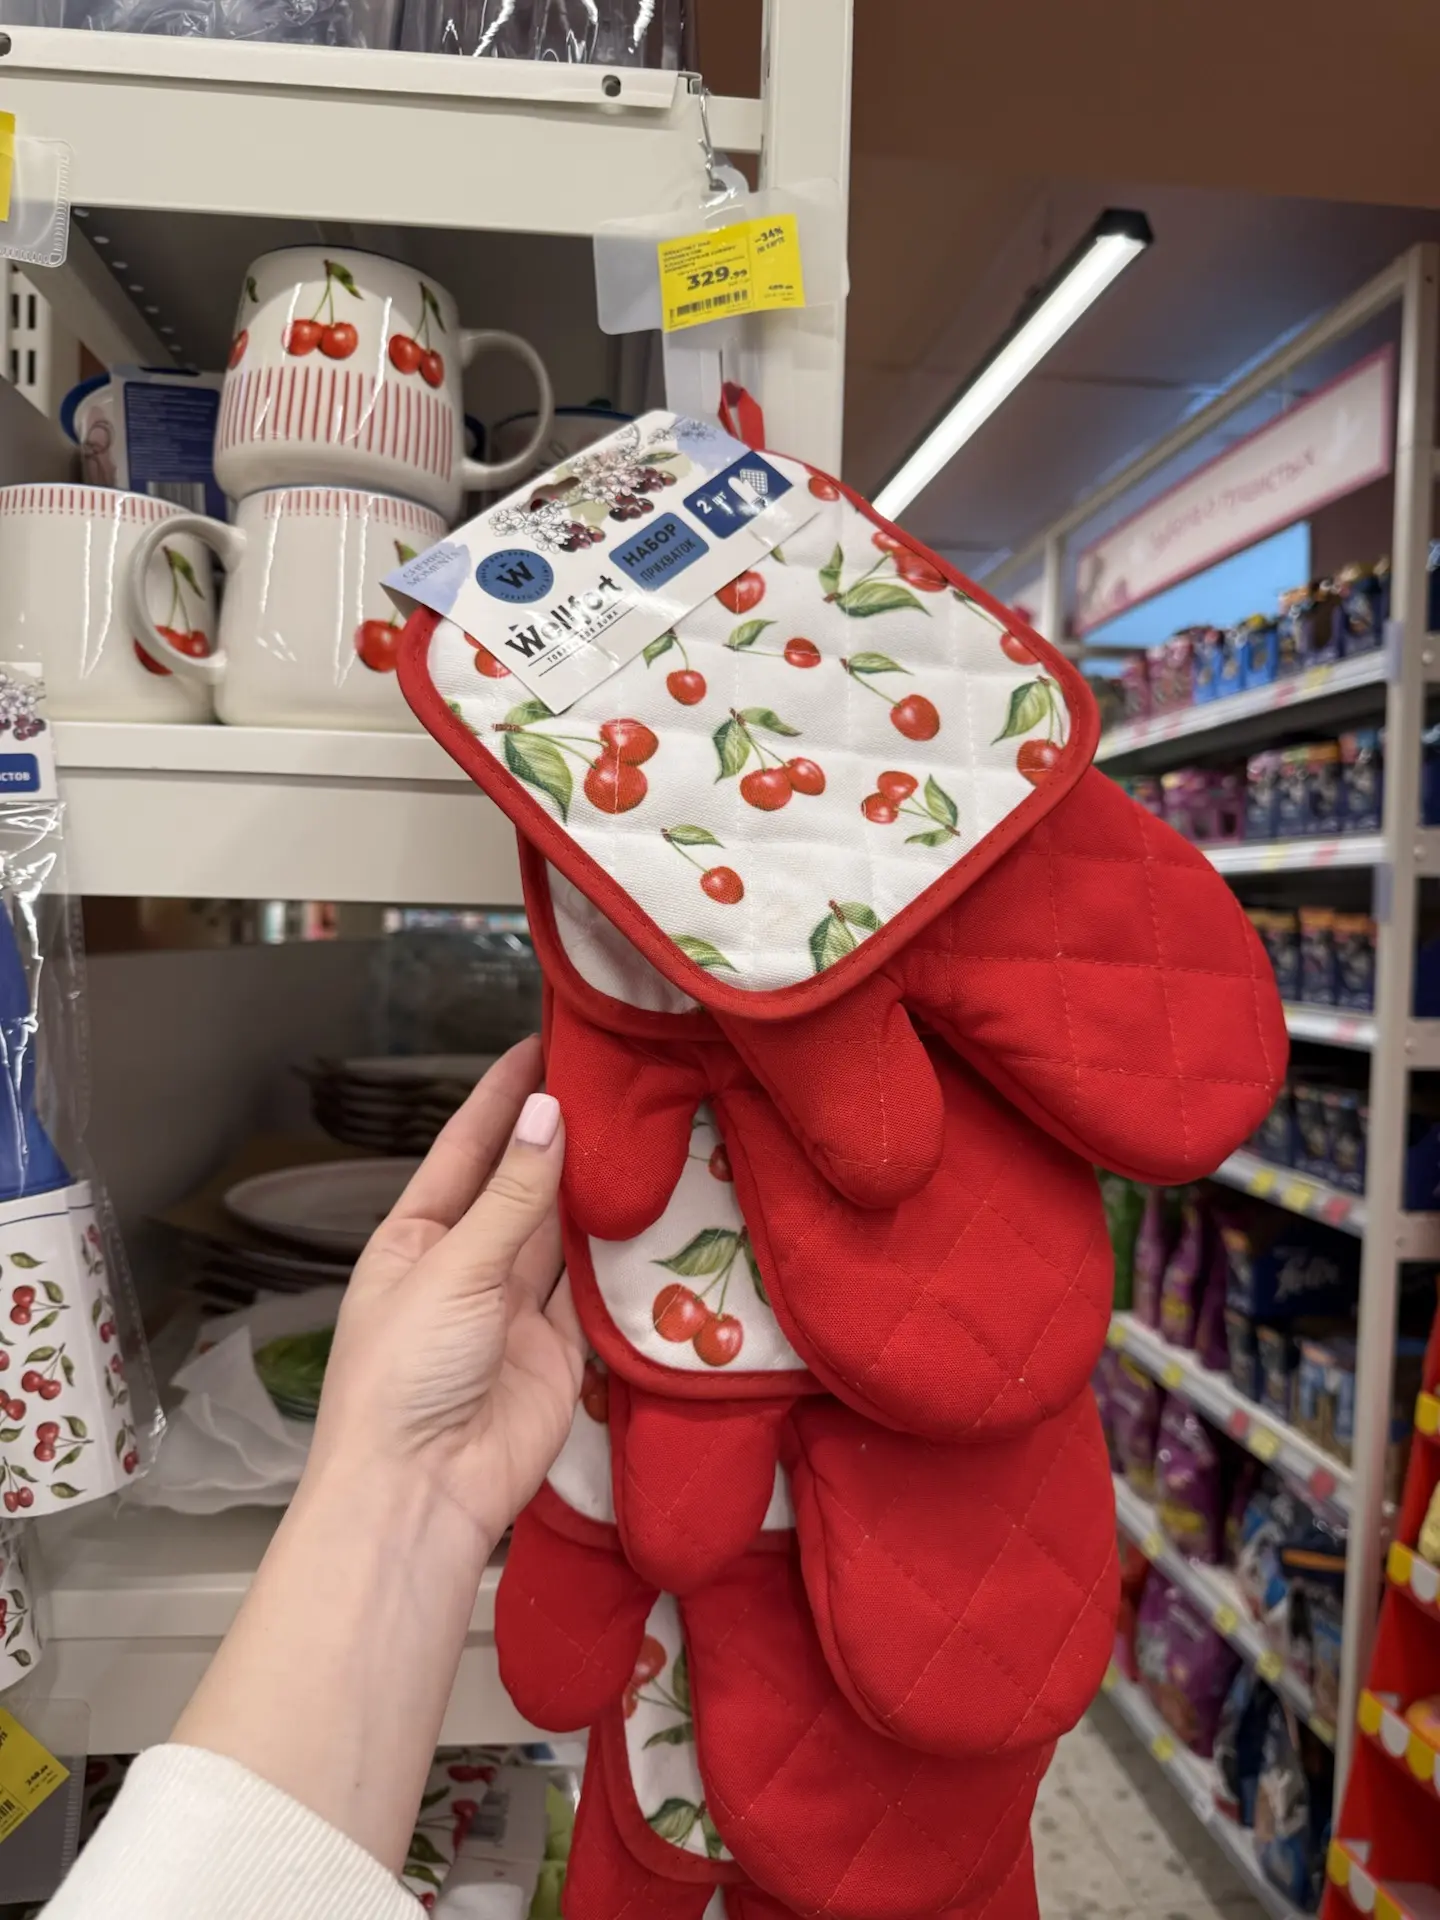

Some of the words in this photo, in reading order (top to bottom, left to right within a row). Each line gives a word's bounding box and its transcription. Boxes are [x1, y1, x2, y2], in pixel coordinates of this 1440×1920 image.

[696, 499, 713, 515] 2
[621, 522, 677, 568] НАБОР
[639, 537, 697, 582] ПРИХВАТОК
[402, 549, 445, 579] CHERRY
[406, 550, 462, 588] MOMENTS
[0, 771, 31, 782] СТОВ
